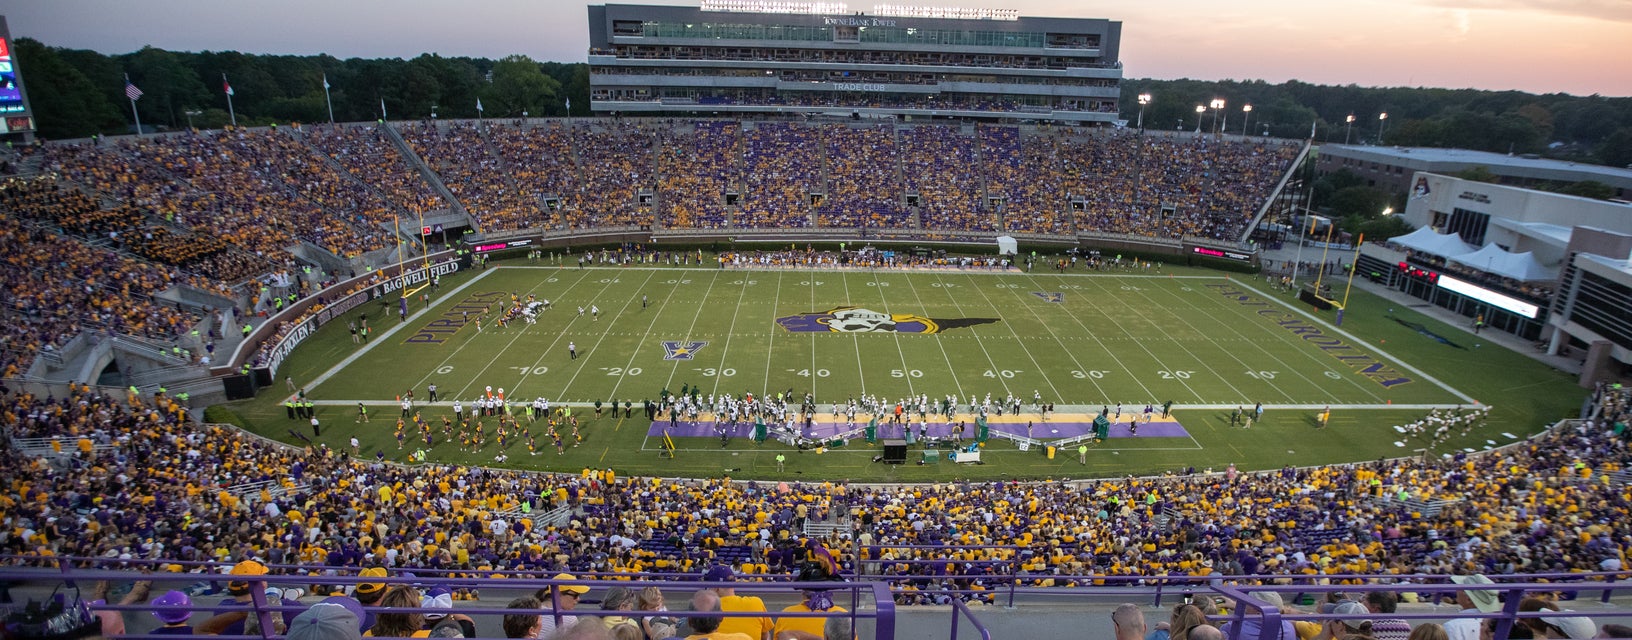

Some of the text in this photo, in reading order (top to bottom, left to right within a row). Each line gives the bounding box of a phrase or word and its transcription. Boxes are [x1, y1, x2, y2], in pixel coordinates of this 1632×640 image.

[871, 18, 896, 27] TOWER
[833, 83, 861, 91] TRADE
[383, 262, 459, 295] BAGWELL FIELD
[401, 290, 508, 346] PIRATES
[1257, 309, 1415, 389] CAROLINA
[437, 365, 454, 375] G
[519, 366, 548, 375] 10
[607, 367, 643, 376] 20
[702, 368, 737, 377] 30
[797, 369, 831, 377] 40
[891, 369, 924, 378] 50
[983, 369, 1015, 379] 40
[1070, 370, 1104, 379] 30
[1157, 370, 1190, 379] 20
[1245, 370, 1275, 379] 10
